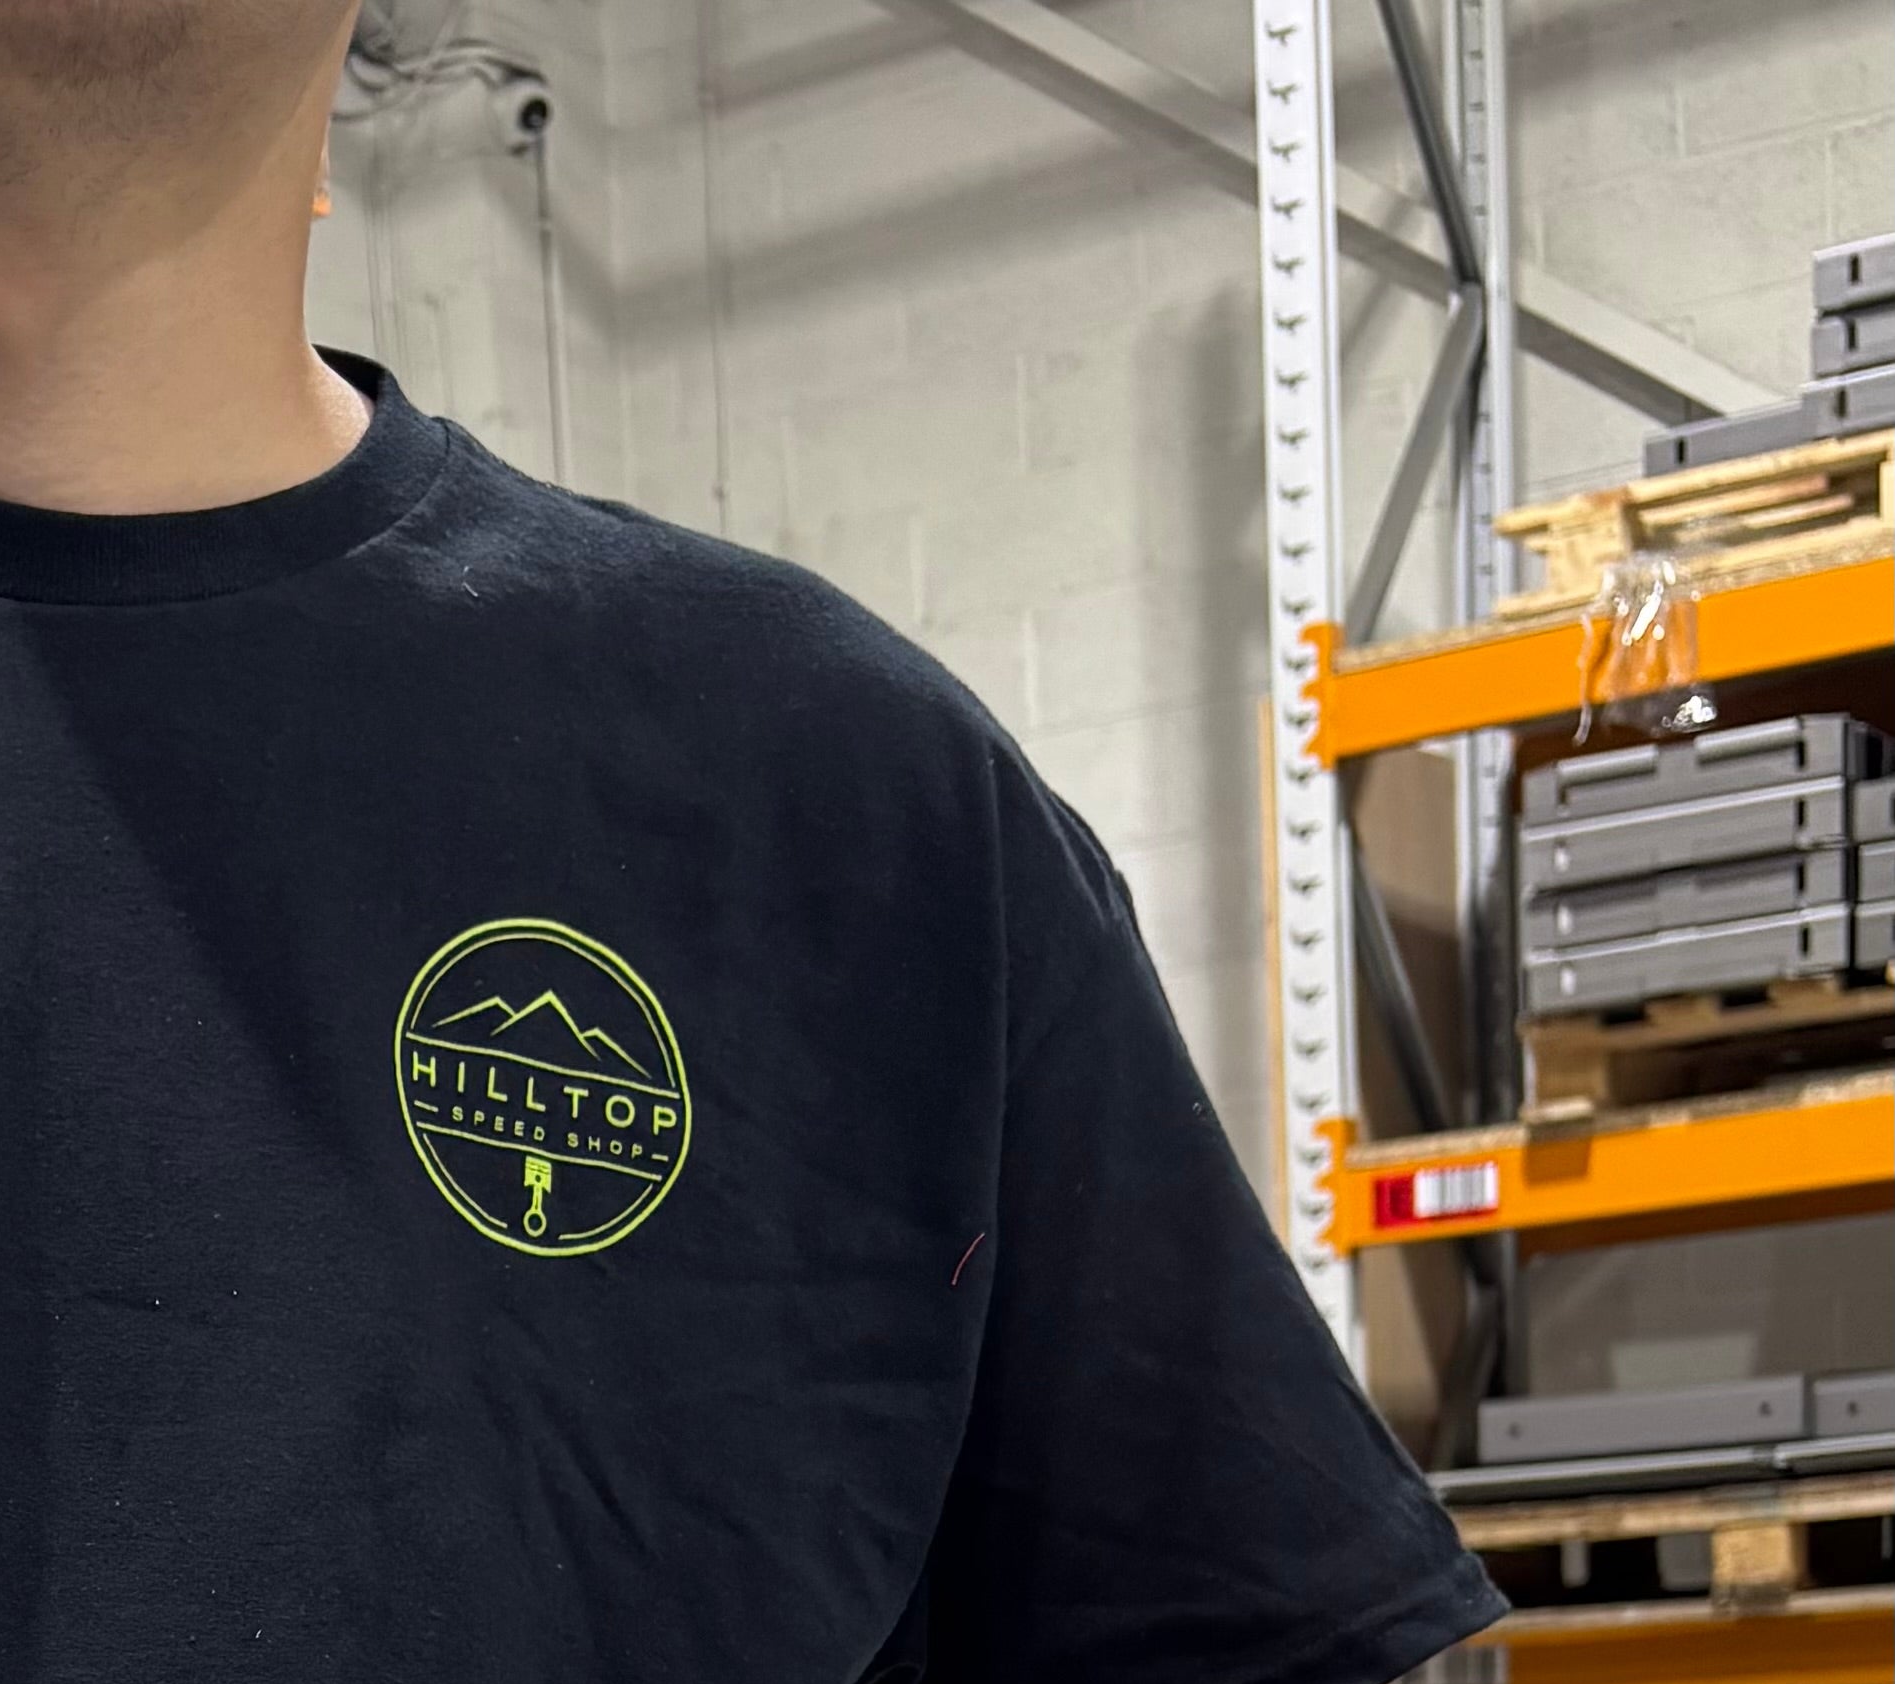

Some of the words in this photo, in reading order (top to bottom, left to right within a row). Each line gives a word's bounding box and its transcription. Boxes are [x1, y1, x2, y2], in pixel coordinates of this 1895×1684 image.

[412, 1050, 678, 1136] HILLTOP
[451, 1105, 546, 1142] SPEED
[567, 1131, 644, 1159] SHOP
